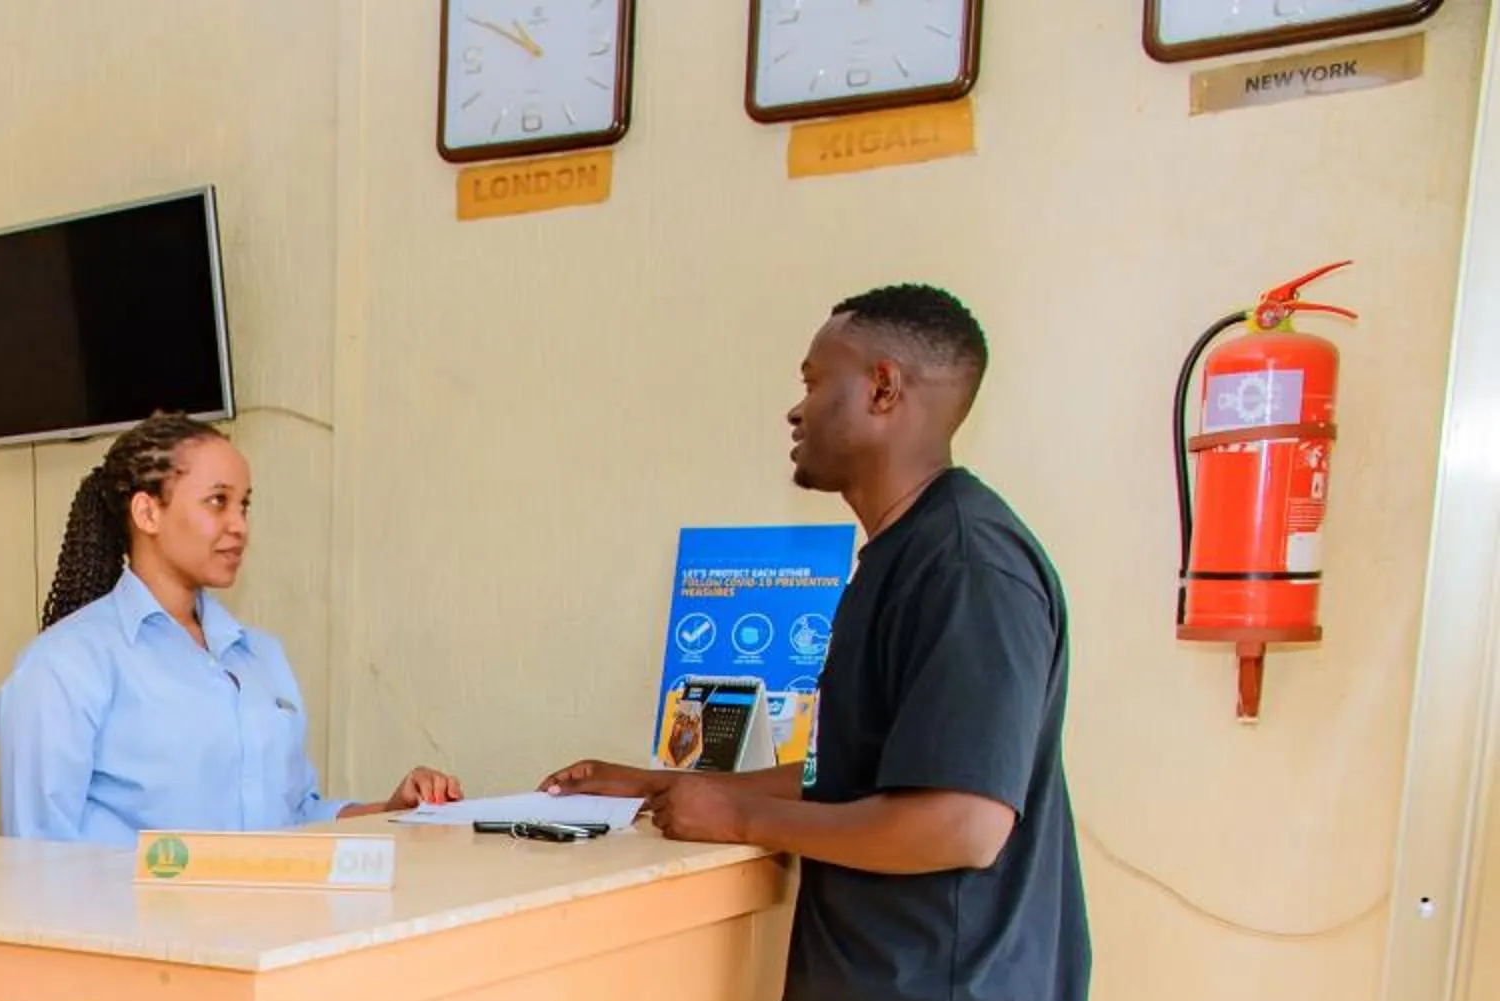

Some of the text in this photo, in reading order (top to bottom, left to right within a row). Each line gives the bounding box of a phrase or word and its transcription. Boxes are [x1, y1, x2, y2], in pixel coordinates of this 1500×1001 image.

[1244, 59, 1359, 94] NEW YORK
[473, 163, 598, 203] LONDON
